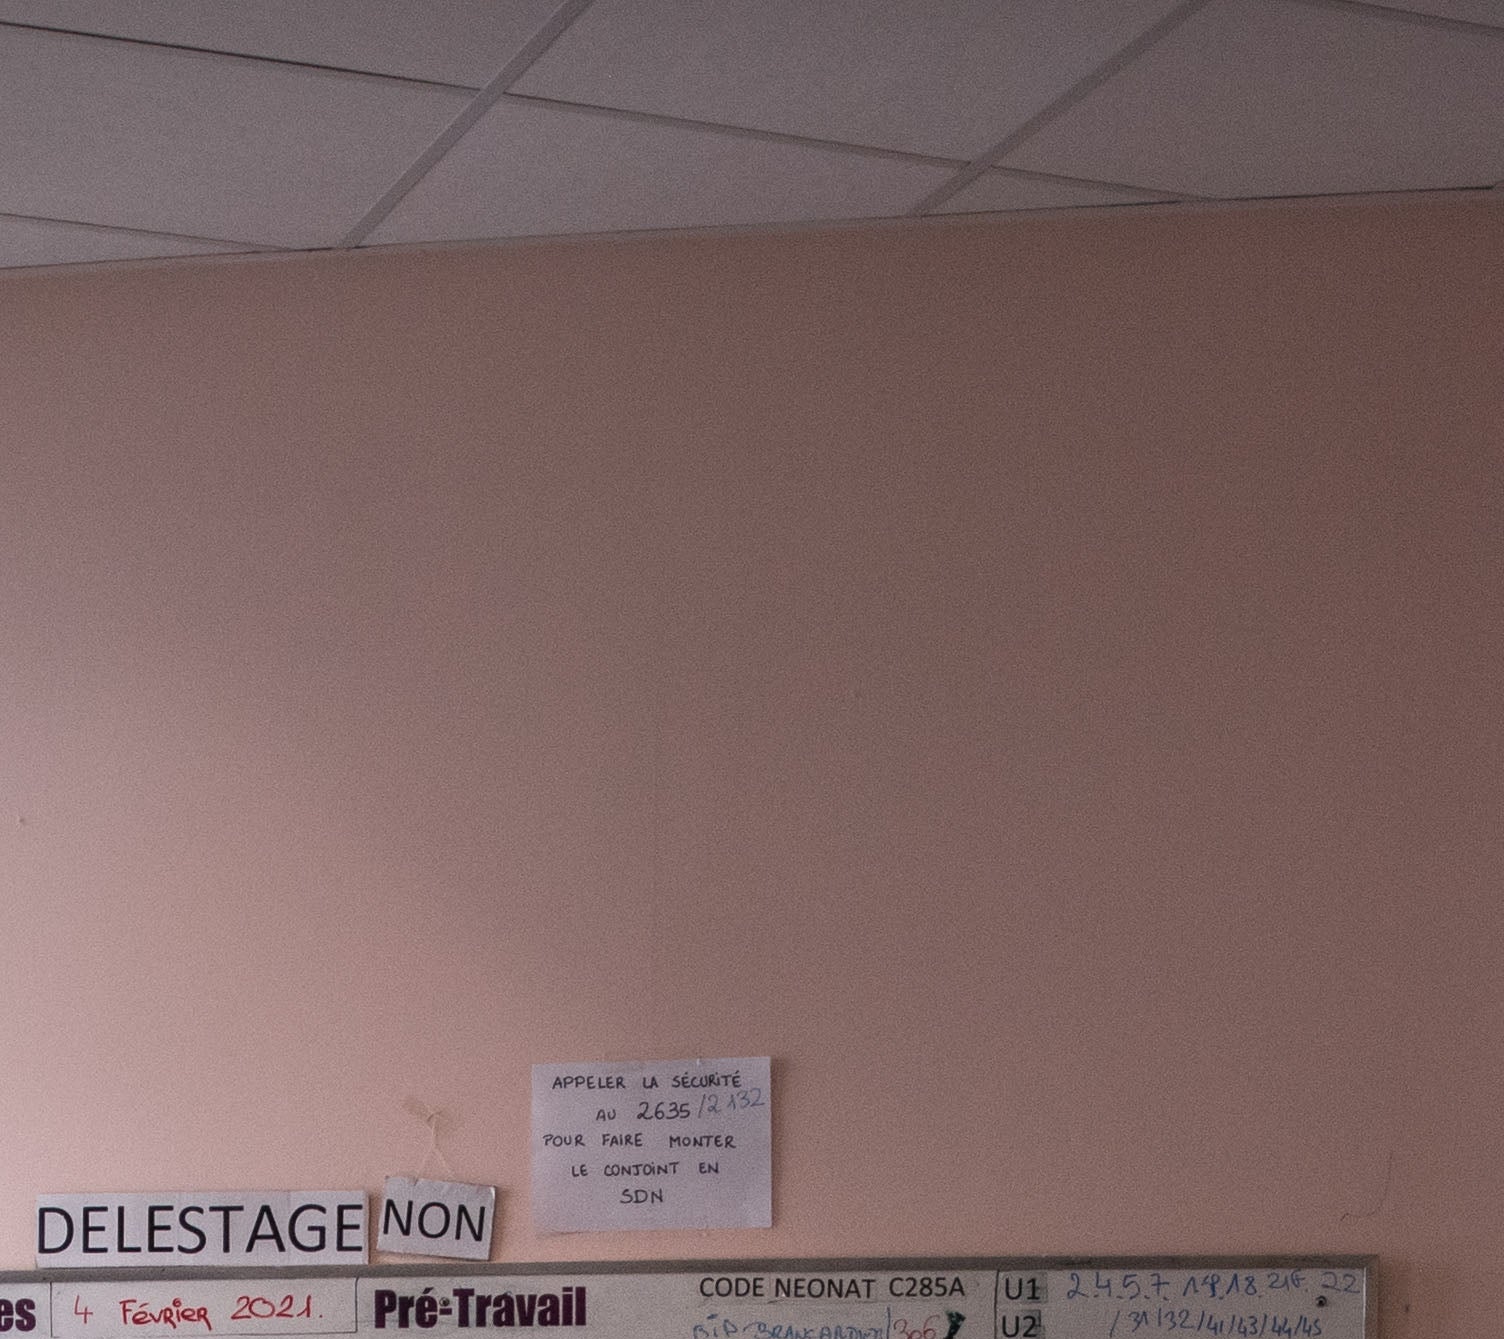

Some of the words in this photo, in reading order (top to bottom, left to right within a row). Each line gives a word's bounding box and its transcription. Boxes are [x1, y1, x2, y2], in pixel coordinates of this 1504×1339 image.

[552, 1075, 626, 1089] APPELER
[642, 1076, 659, 1089] LA
[595, 1108, 617, 1121] AU
[542, 1134, 585, 1148] POUR
[602, 1133, 643, 1148] FAIRE
[669, 1135, 737, 1149] MONTER
[571, 1164, 589, 1178] LE
[603, 1161, 680, 1177] CONJOINT
[698, 1162, 720, 1175] EN
[619, 1189, 664, 1204] SDN
[39, 1205, 364, 1254] DELESTAGE
[383, 1199, 487, 1242] NON
[699, 1277, 765, 1298] CODE
[774, 1278, 877, 1299] NEONAT
[888, 1276, 966, 1298] C285A
[1004, 1276, 1041, 1300] U1
[74, 1297, 93, 1324] 4
[373, 1286, 587, 1330] Pré-Travail
[1002, 1314, 1040, 1338] U2
